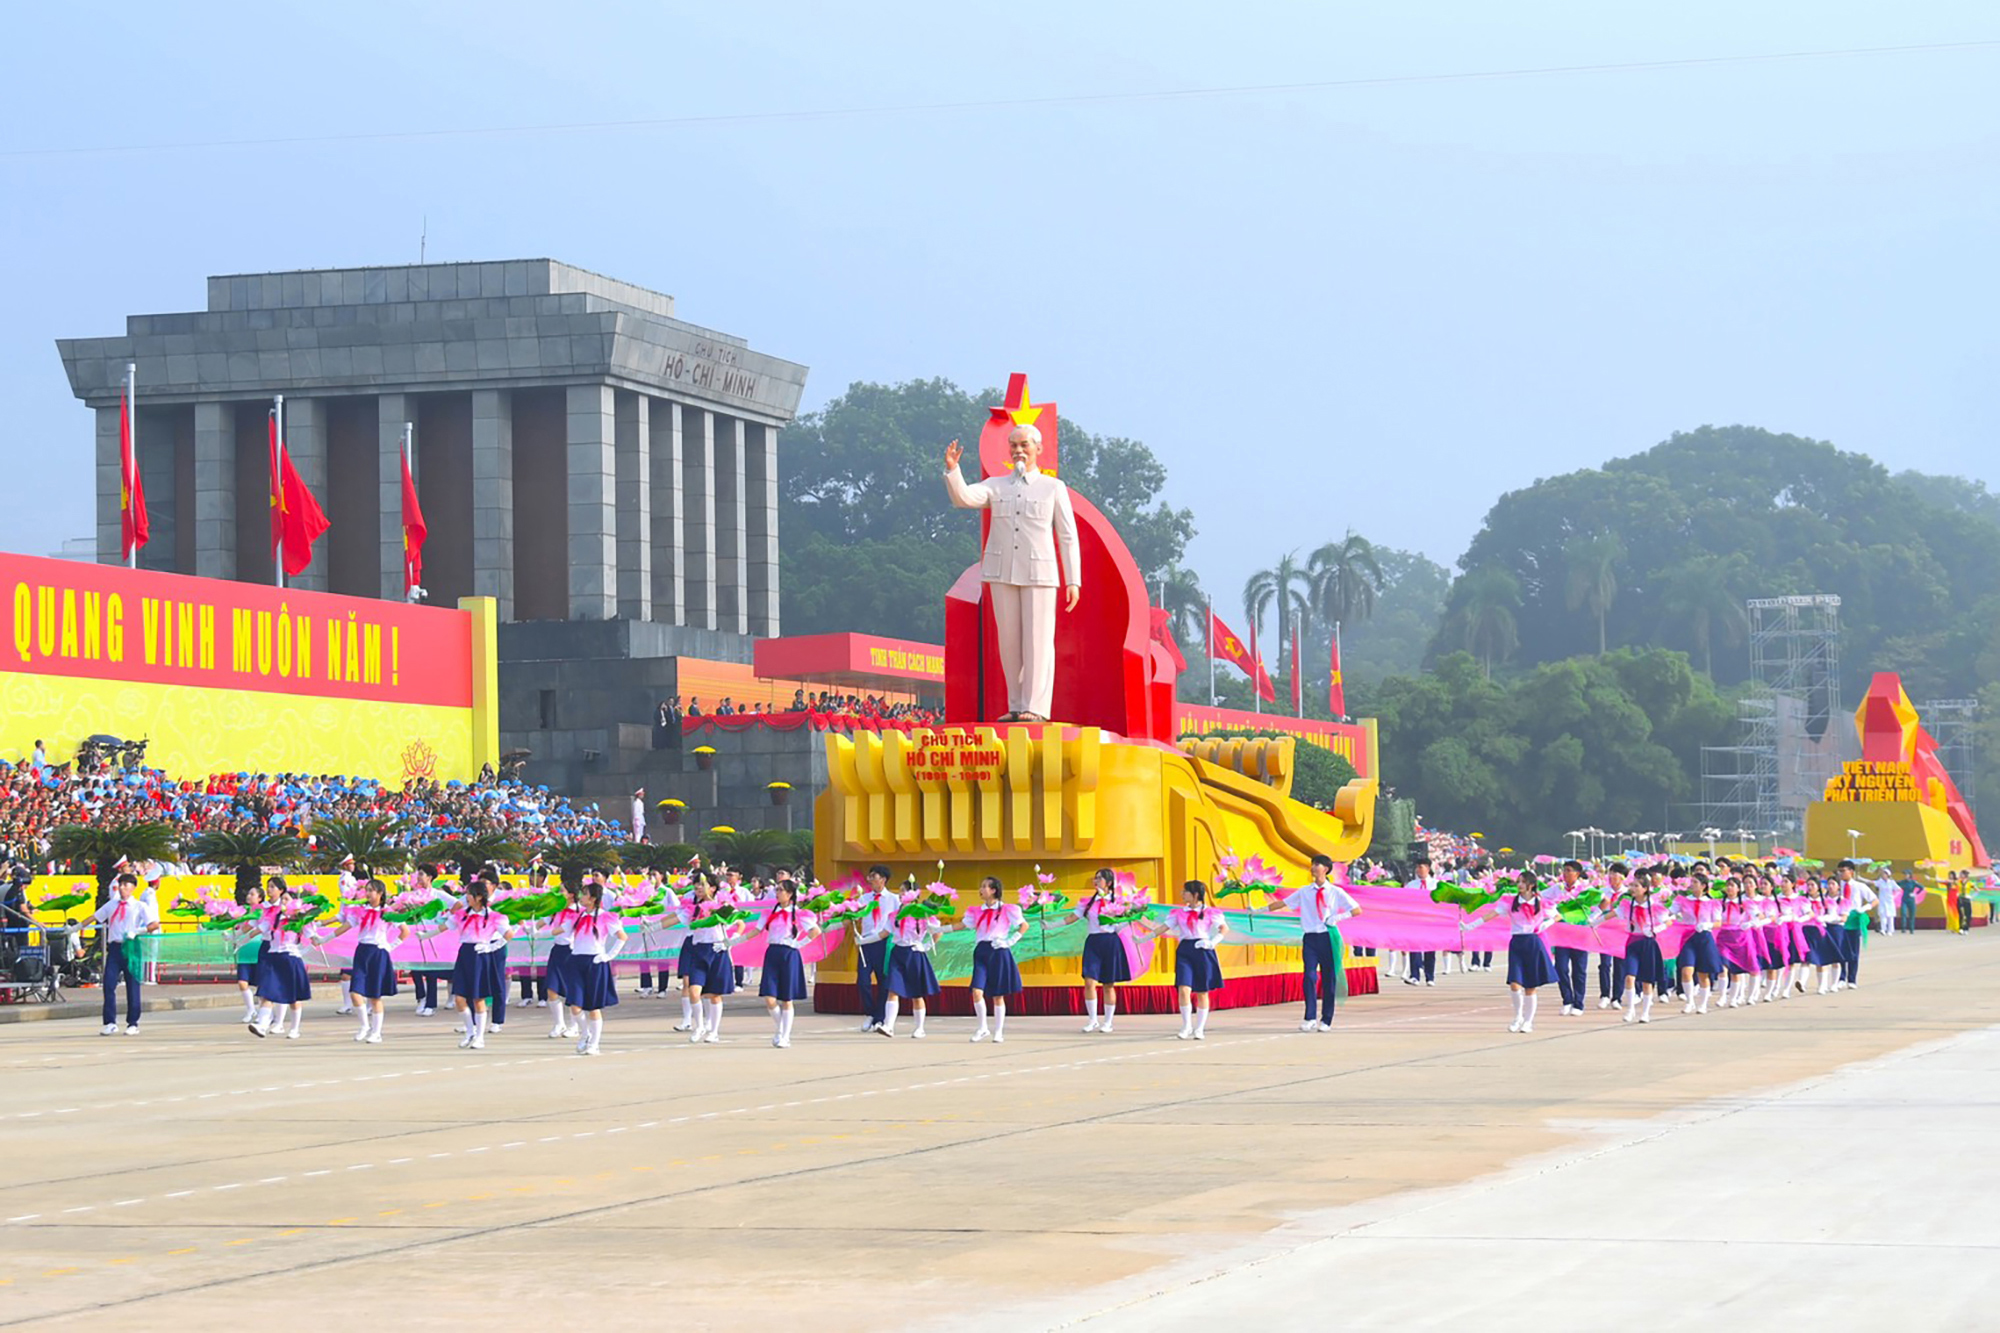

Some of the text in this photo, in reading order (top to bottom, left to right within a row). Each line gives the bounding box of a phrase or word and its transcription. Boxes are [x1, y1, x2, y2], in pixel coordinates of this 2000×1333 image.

[14, 582, 123, 662] QUANG
[142, 597, 214, 670] VINH
[232, 602, 311, 678] MUÔN
[921, 730, 983, 748] CHỦ TỊCH
[906, 746, 1000, 767] HỒ CHÍ MINH
[1876, 761, 1911, 774] NAM
